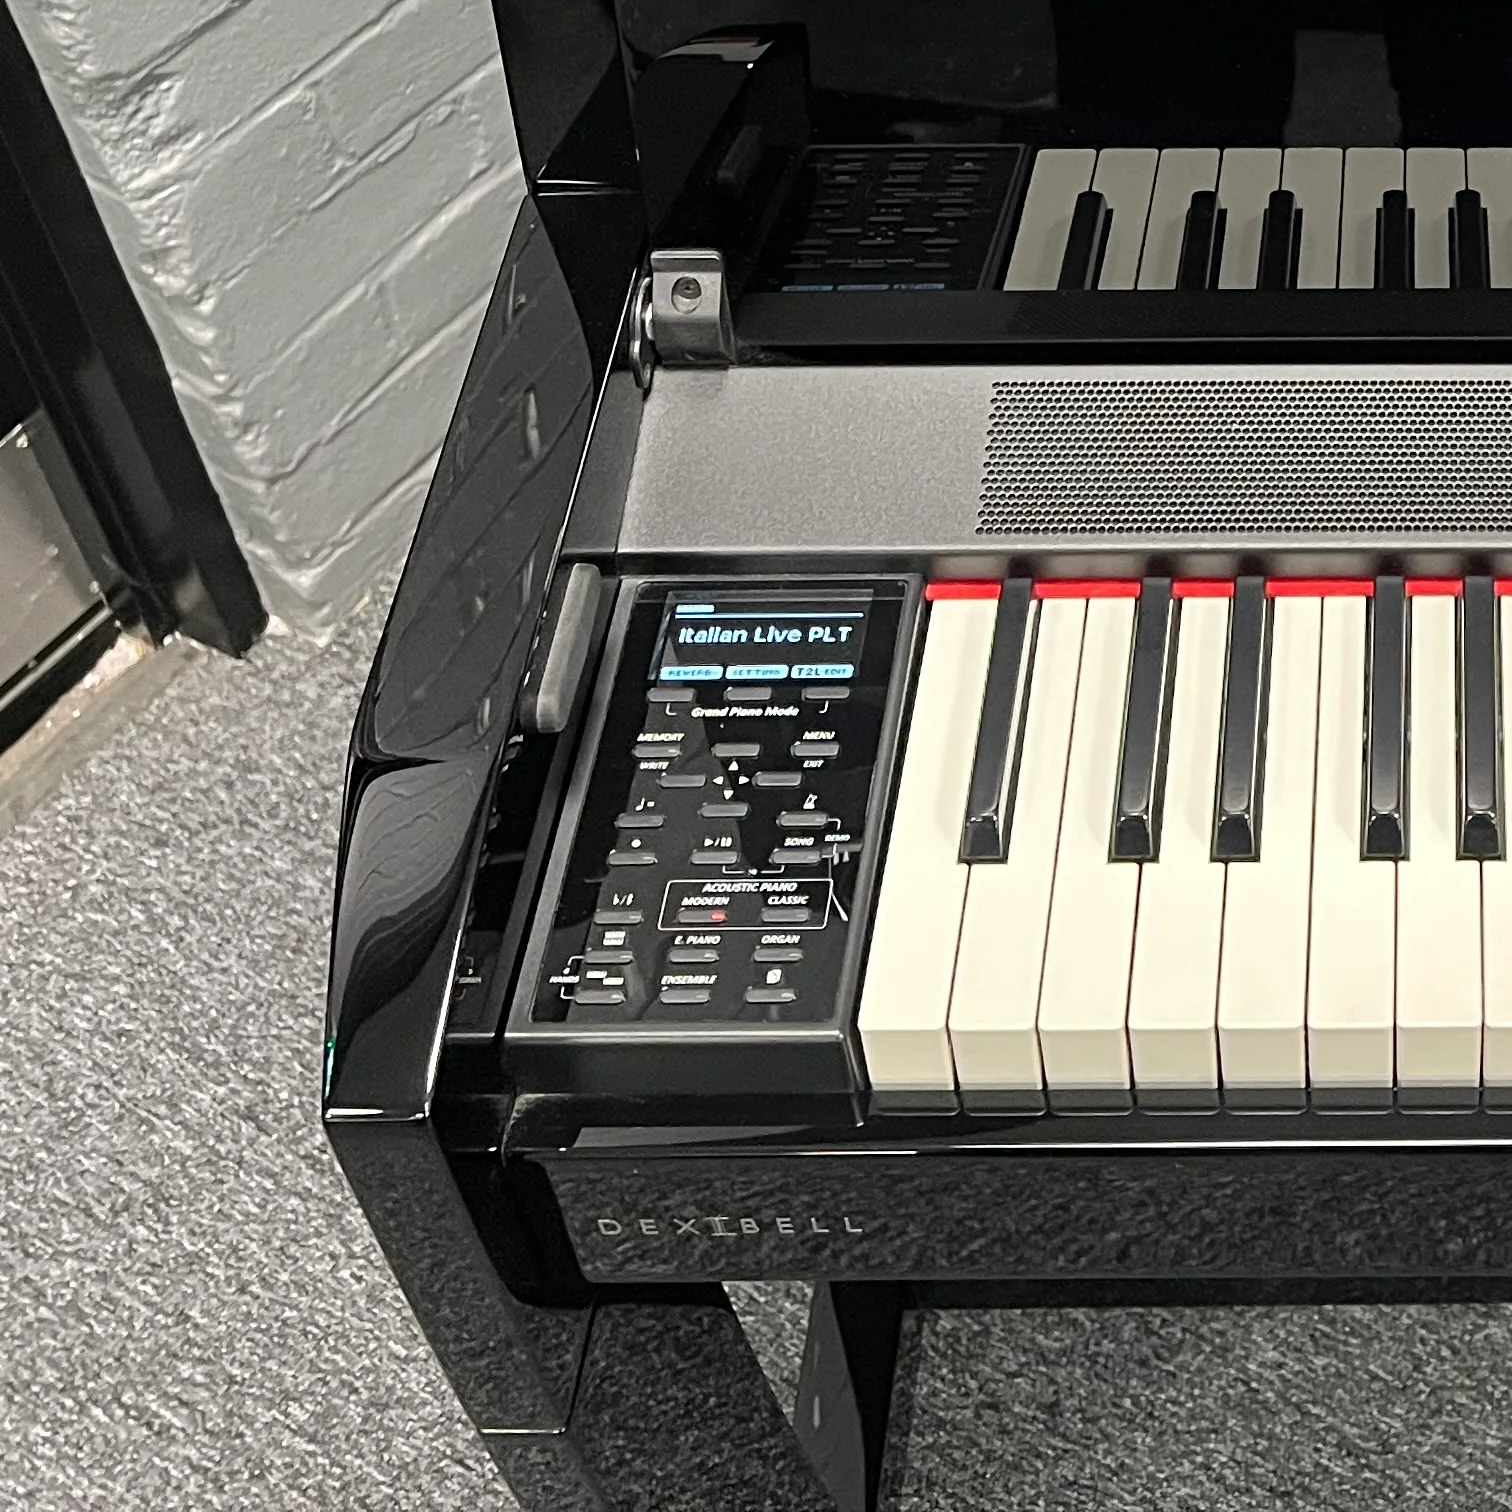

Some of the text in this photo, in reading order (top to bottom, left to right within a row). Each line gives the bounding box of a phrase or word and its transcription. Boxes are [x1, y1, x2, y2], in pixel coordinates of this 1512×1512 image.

[679, 625, 853, 644] Italian Live PLT
[798, 667, 821, 677] T2L
[690, 706, 800, 718] Grand Piano Mode
[637, 733, 685, 742] MEMORY
[803, 731, 836, 740] MENU
[784, 837, 815, 847] SONG
[702, 882, 798, 893] ACOUSTIC PIANO
[681, 896, 730, 906] MODERN
[767, 895, 810, 906] CLASSIC
[674, 935, 722, 945] E. PIANO
[760, 934, 801, 944] ORGAN
[660, 975, 718, 985] ENSEMBLE
[597, 1214, 863, 1236] DEXIBELL
